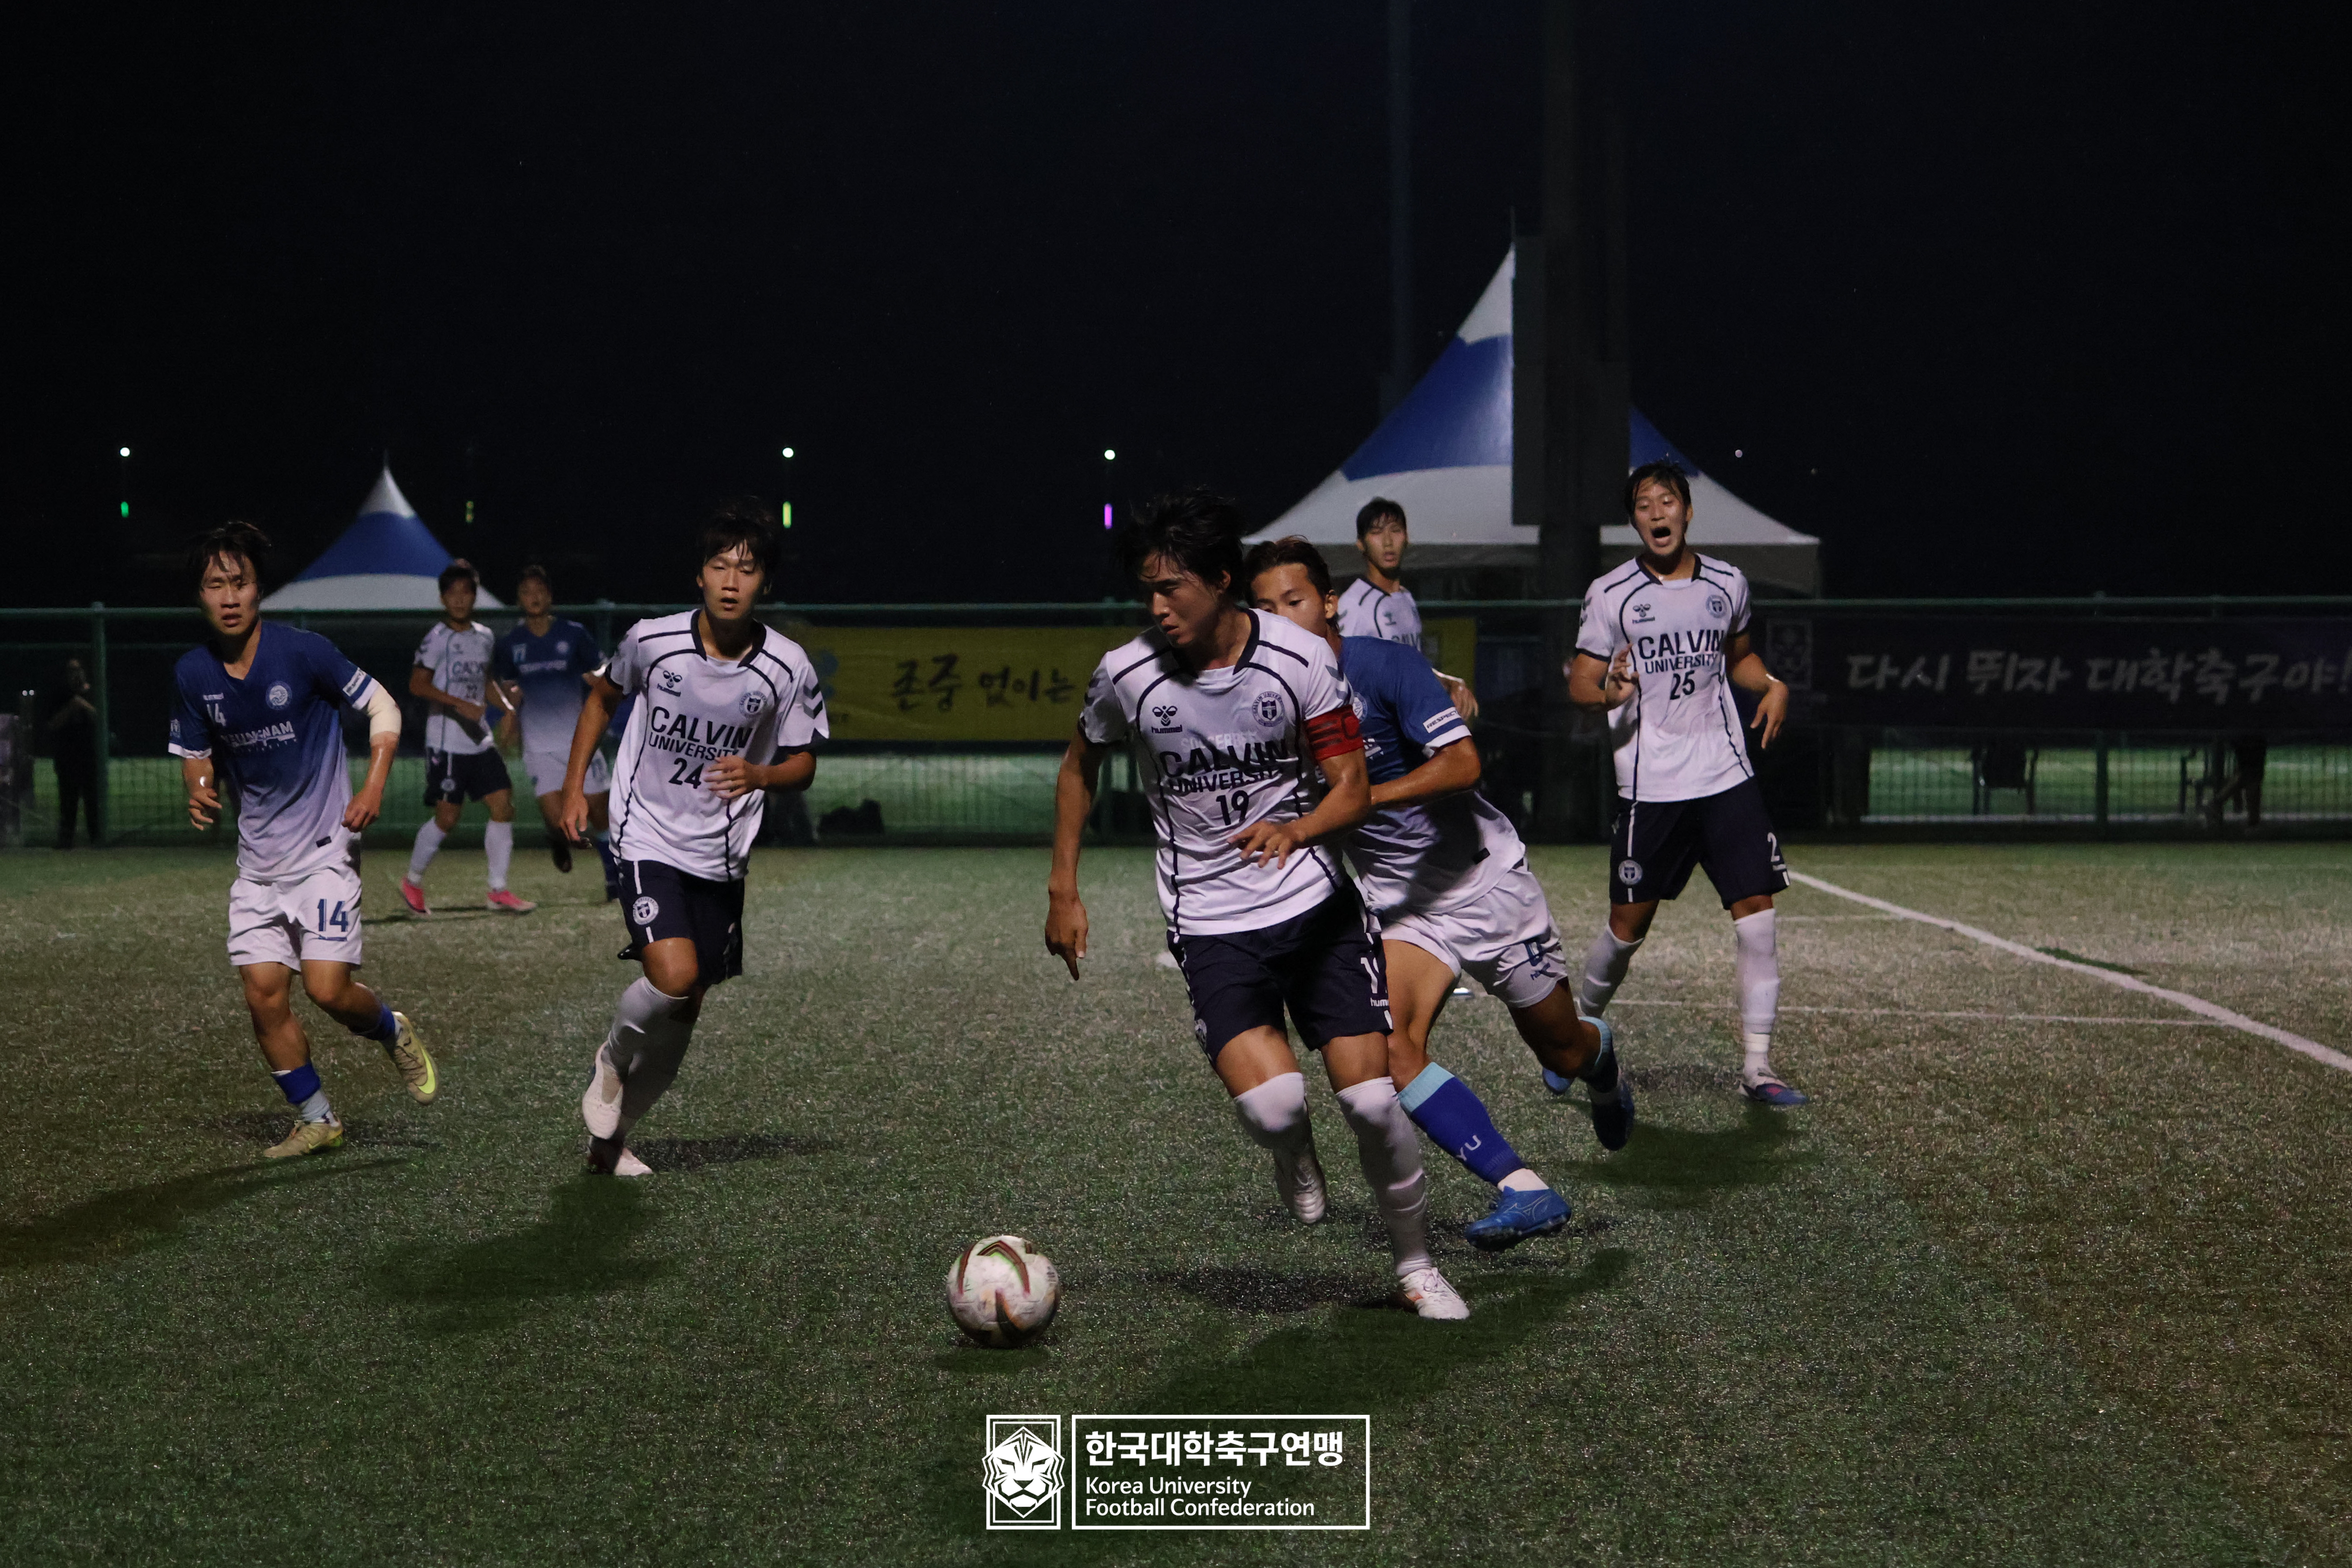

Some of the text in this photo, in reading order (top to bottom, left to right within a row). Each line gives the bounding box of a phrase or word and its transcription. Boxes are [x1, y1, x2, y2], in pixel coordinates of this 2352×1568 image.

[1638, 629, 1724, 660] CALVIN
[1645, 654, 1717, 674] UNIVERSITY
[1847, 653, 1950, 692] 다시
[1966, 649, 2072, 695] 뛰자
[890, 654, 1077, 712] 존중 없이는
[1670, 670, 1695, 700] 25
[651, 706, 752, 749] CALVIN
[1151, 725, 1183, 734] hummel
[669, 758, 704, 789] 24
[1159, 738, 1288, 778] CALVIN
[1216, 790, 1249, 826] 19
[1767, 832, 1780, 863] 2
[317, 898, 349, 932] 14
[1456, 1135, 1482, 1161] YU
